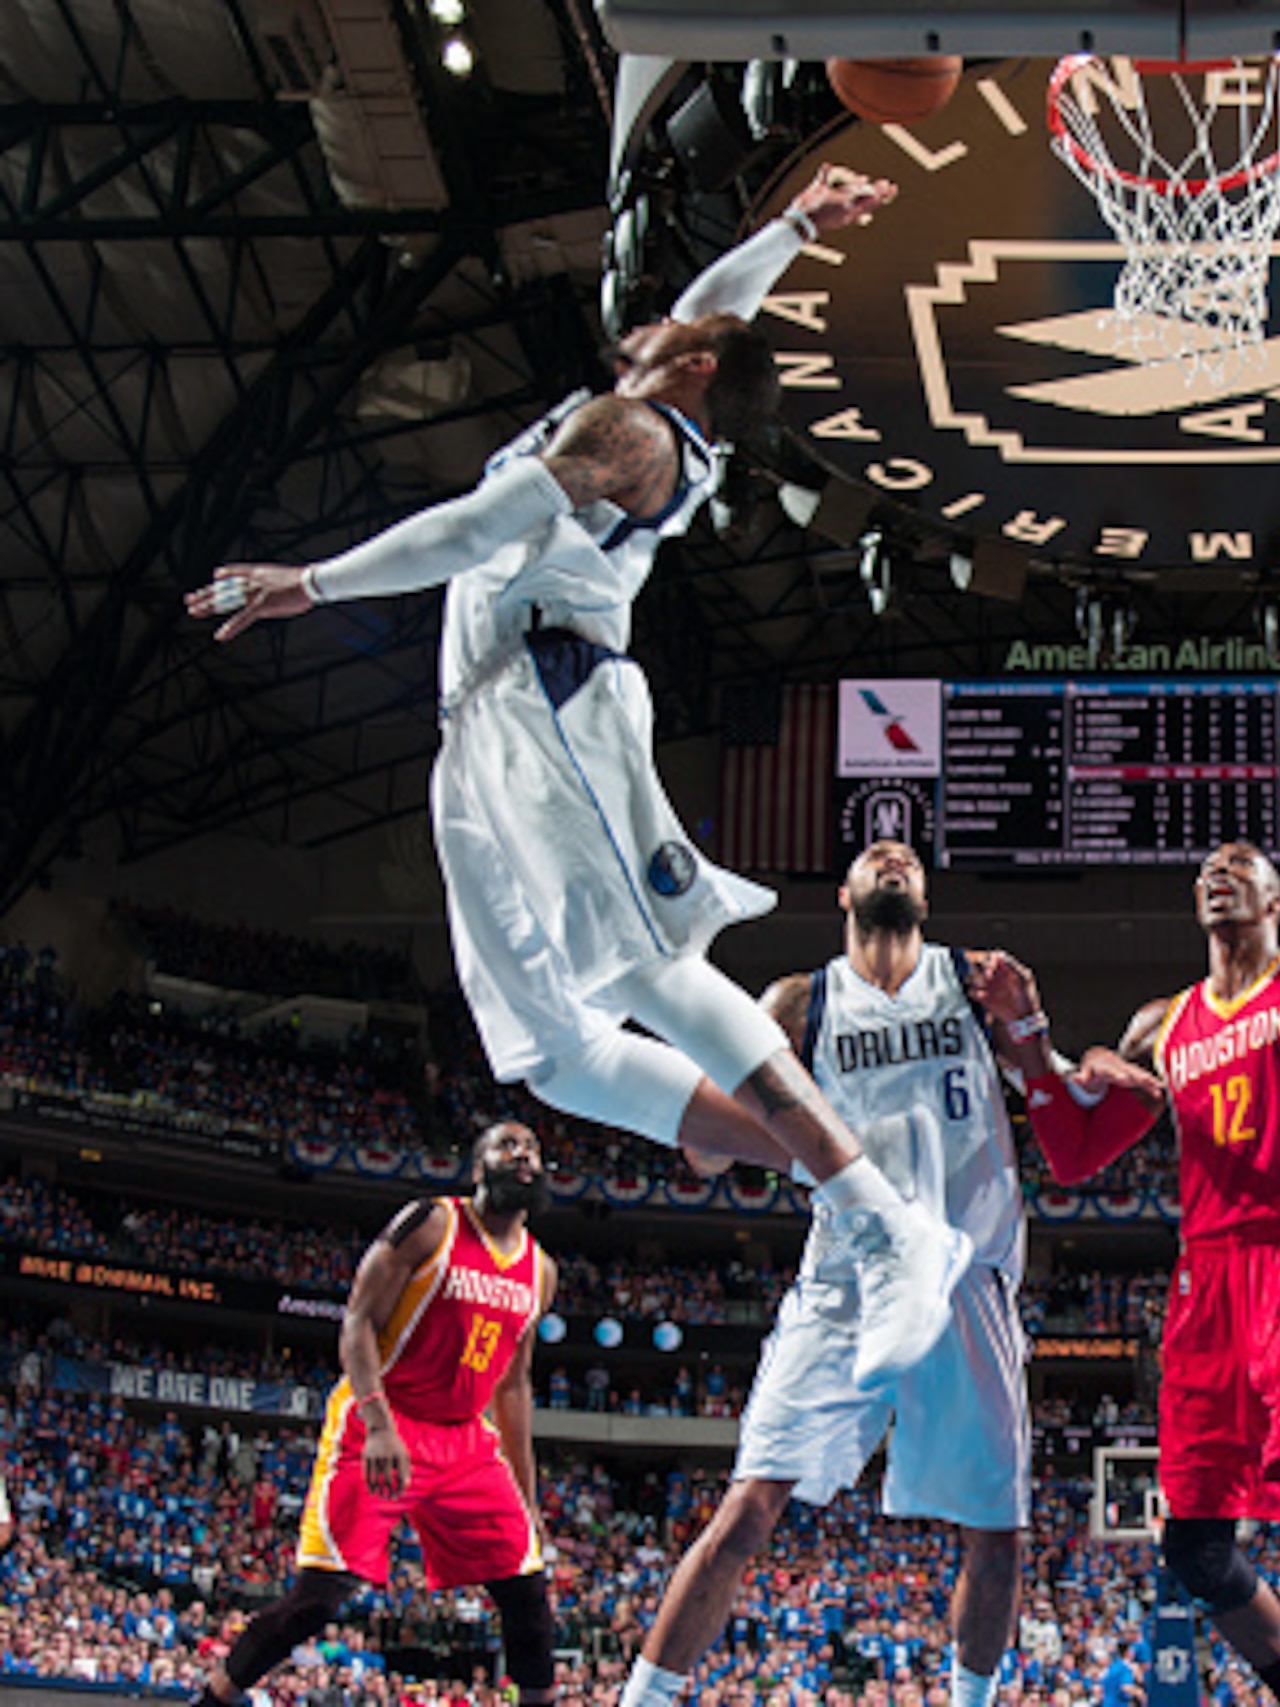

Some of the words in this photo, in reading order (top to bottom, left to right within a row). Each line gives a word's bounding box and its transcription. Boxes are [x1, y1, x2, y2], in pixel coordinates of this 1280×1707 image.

[836, 1017, 962, 1073] DALLAS
[944, 1065, 970, 1121] 6
[1208, 1073, 1257, 1147] 12
[459, 1312, 502, 1374] 13
[110, 1364, 153, 1399] WE
[156, 1369, 204, 1404] ARE
[208, 1376, 255, 1411] ONE
